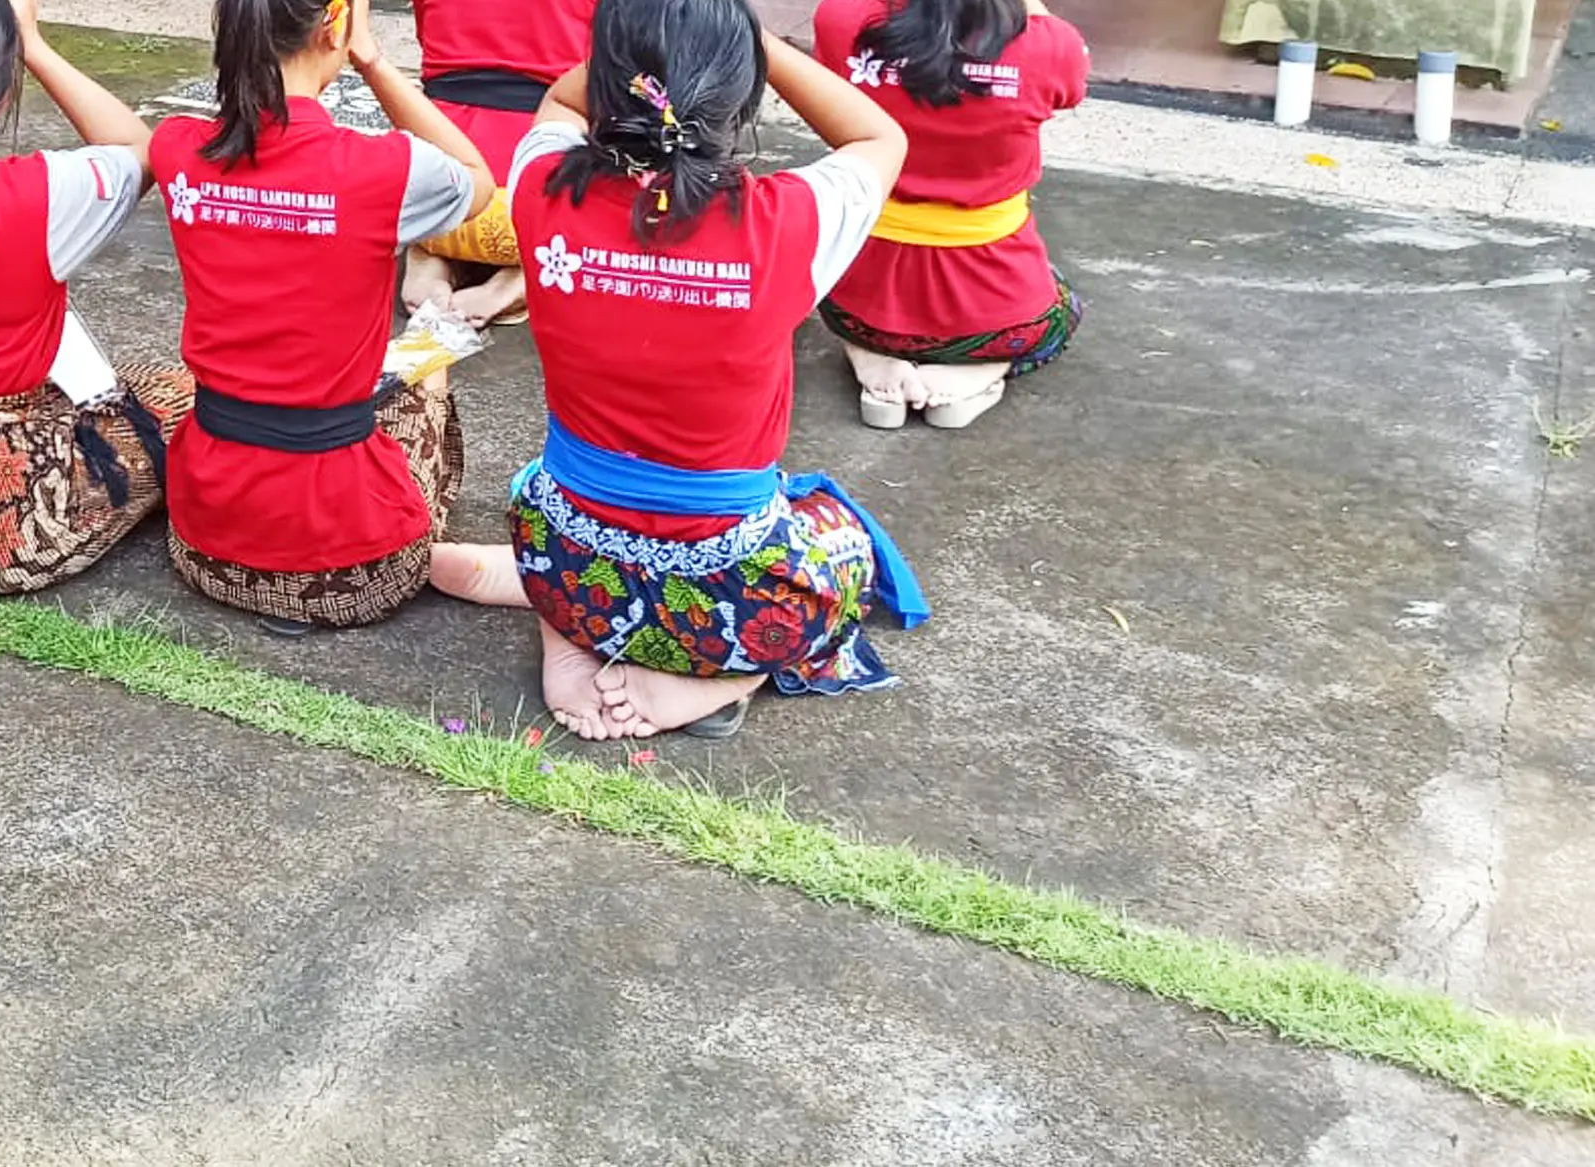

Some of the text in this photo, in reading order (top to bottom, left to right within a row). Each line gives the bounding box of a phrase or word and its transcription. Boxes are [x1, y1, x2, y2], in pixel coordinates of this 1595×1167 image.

[199, 181, 221, 198] LPK
[581, 246, 751, 280] LPK HOSHI GAKUEN BALI
